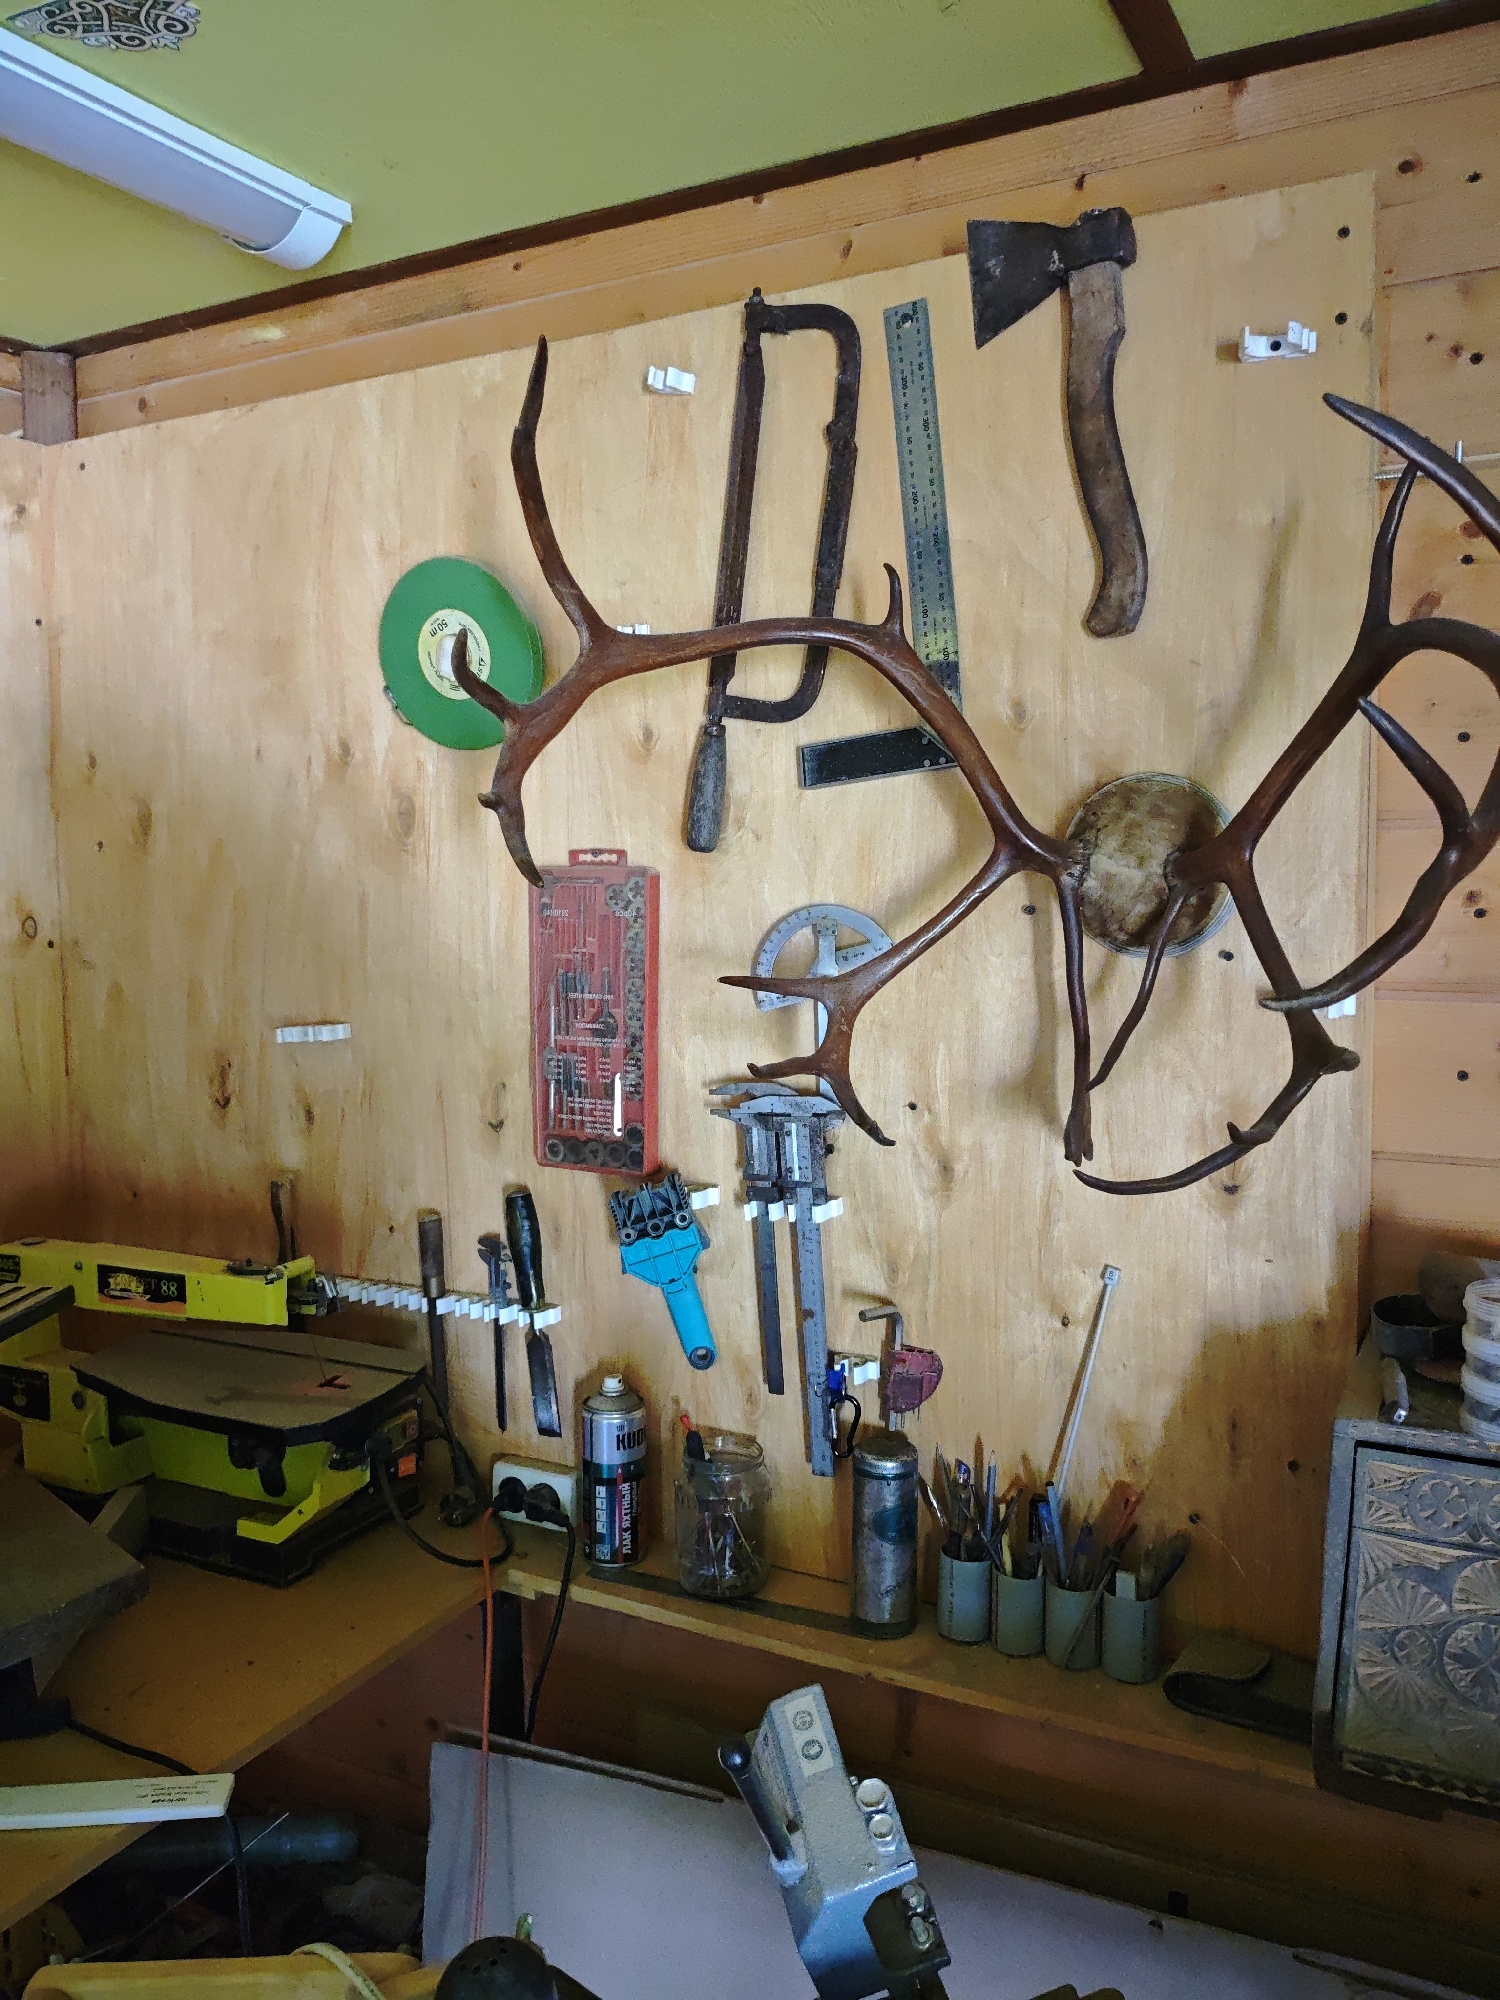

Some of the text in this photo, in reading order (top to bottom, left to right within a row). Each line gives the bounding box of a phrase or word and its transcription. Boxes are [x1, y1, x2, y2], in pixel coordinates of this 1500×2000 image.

[160, 1279, 177, 1297] 88
[616, 1425, 646, 1451] KUD
[619, 1482, 632, 1554] ЛАК ЯХТНЫЙ
